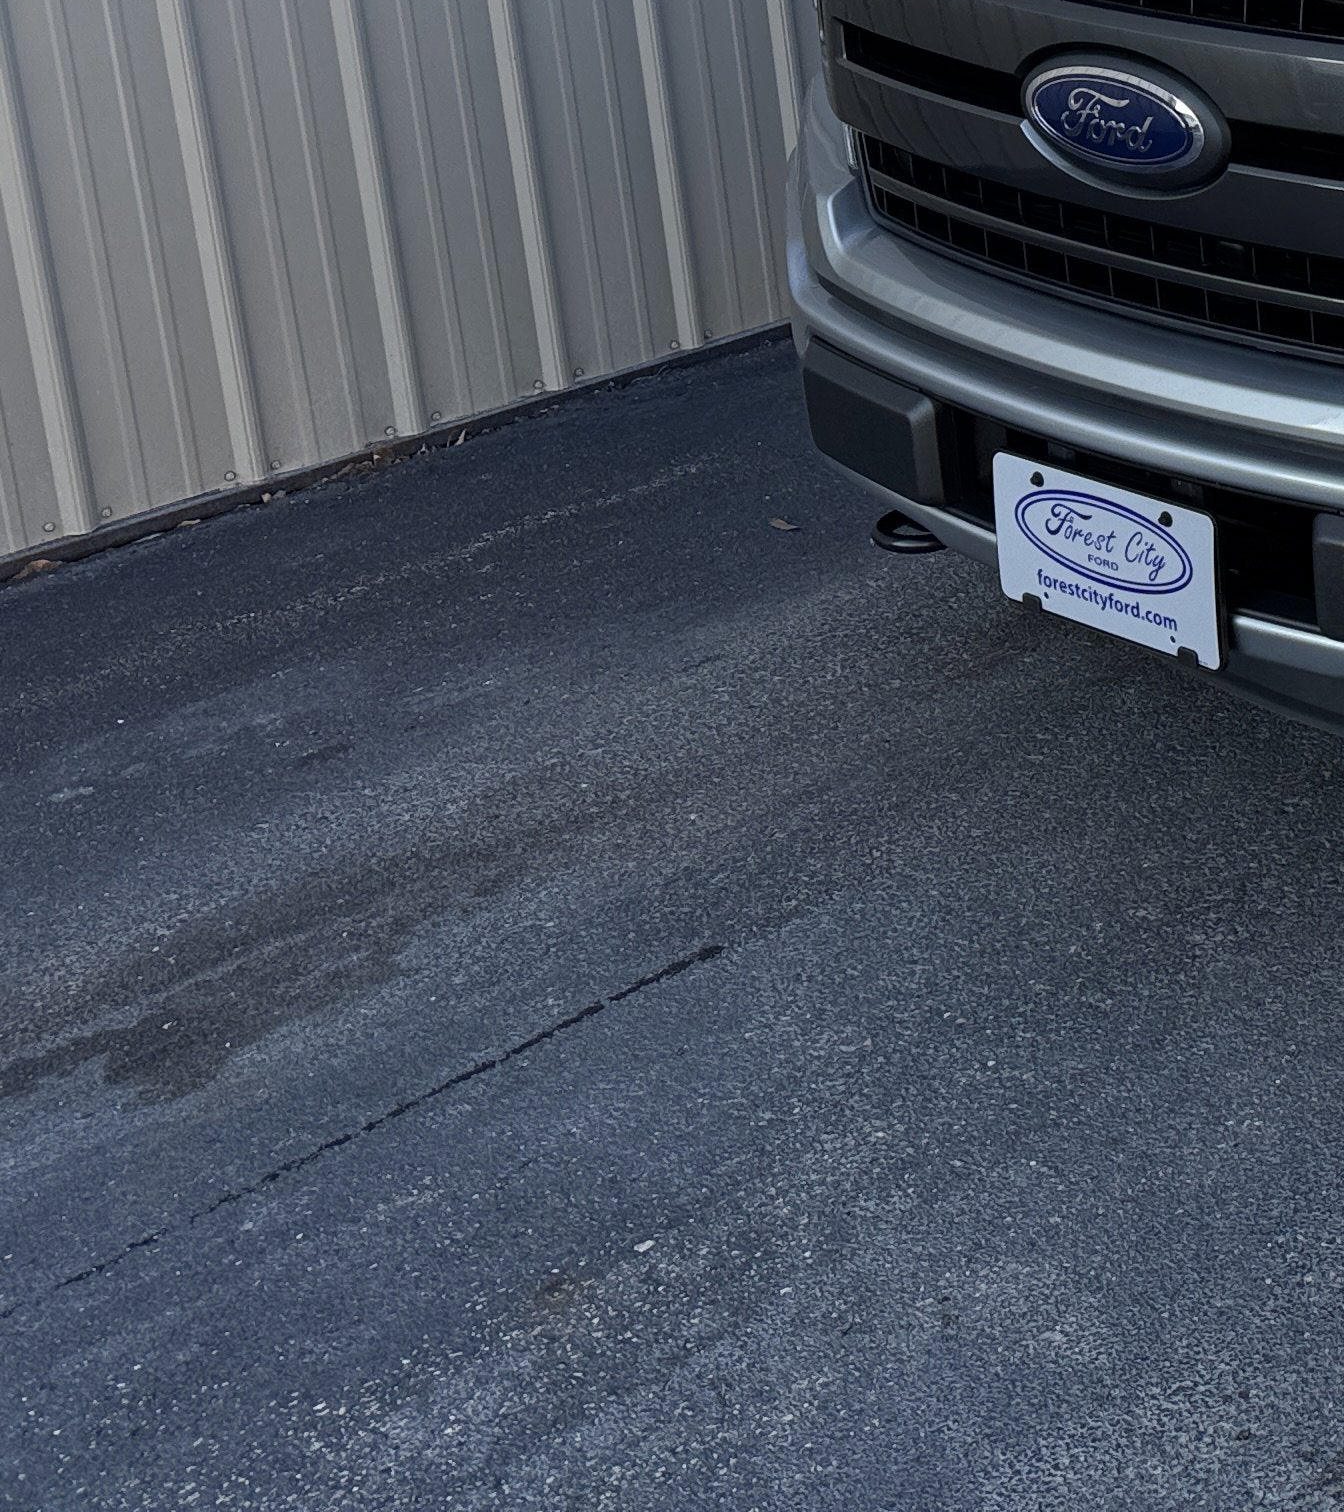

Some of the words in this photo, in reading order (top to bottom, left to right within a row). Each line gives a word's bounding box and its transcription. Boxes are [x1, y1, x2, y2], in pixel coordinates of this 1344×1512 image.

[1060, 87, 1153, 152] Ford
[1044, 503, 1117, 554] Forest
[1124, 531, 1166, 582] City
[1087, 553, 1119, 572] FORD
[1037, 568, 1178, 632] forestcityford.com
